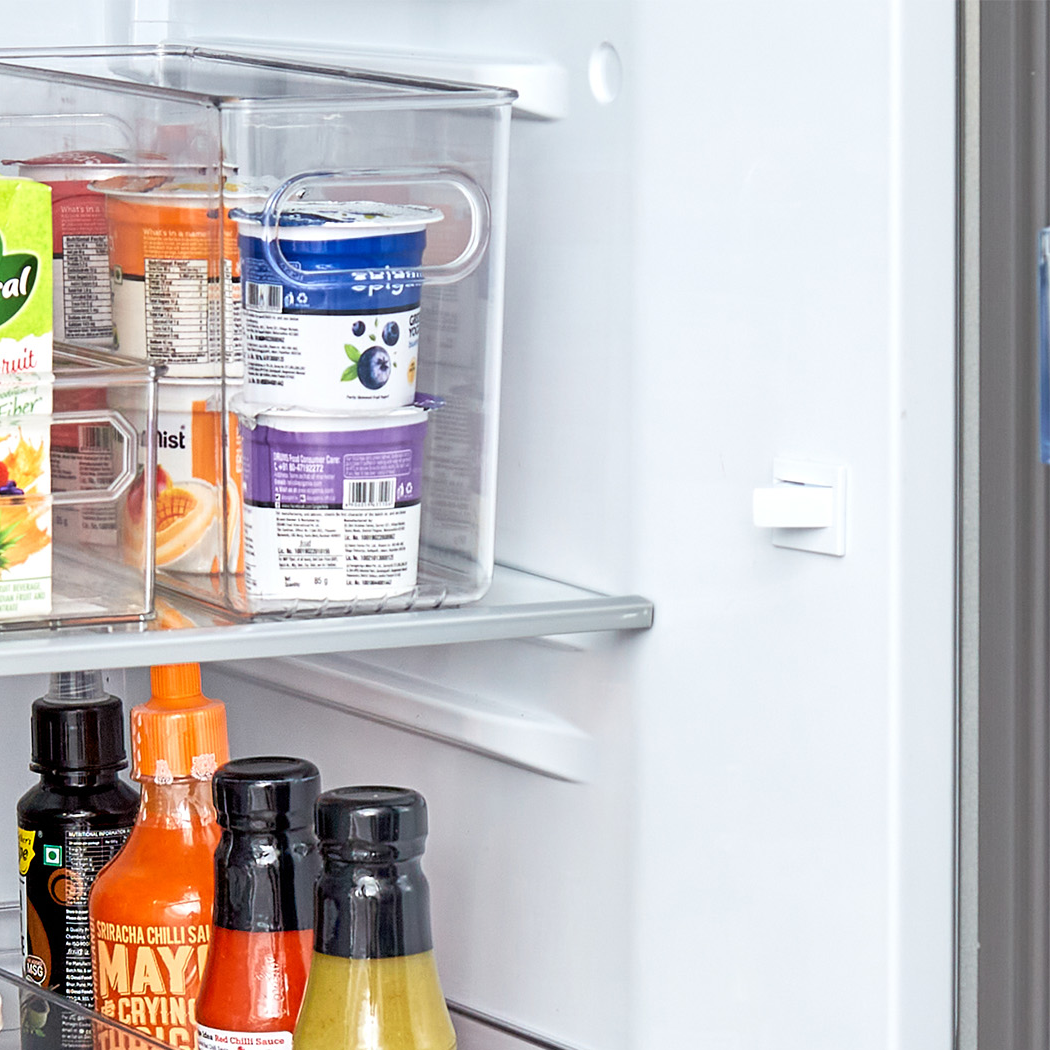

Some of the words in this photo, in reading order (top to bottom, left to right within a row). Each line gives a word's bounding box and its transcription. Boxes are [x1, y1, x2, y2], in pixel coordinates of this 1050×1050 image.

[96, 920, 145, 944] SRIRACHA
[146, 926, 185, 945] CHILLI
[27, 962, 43, 978] MSG
[214, 1034, 229, 1044] Red
[230, 1036, 254, 1045] Chilli
[255, 1037, 285, 1046] Sauce
